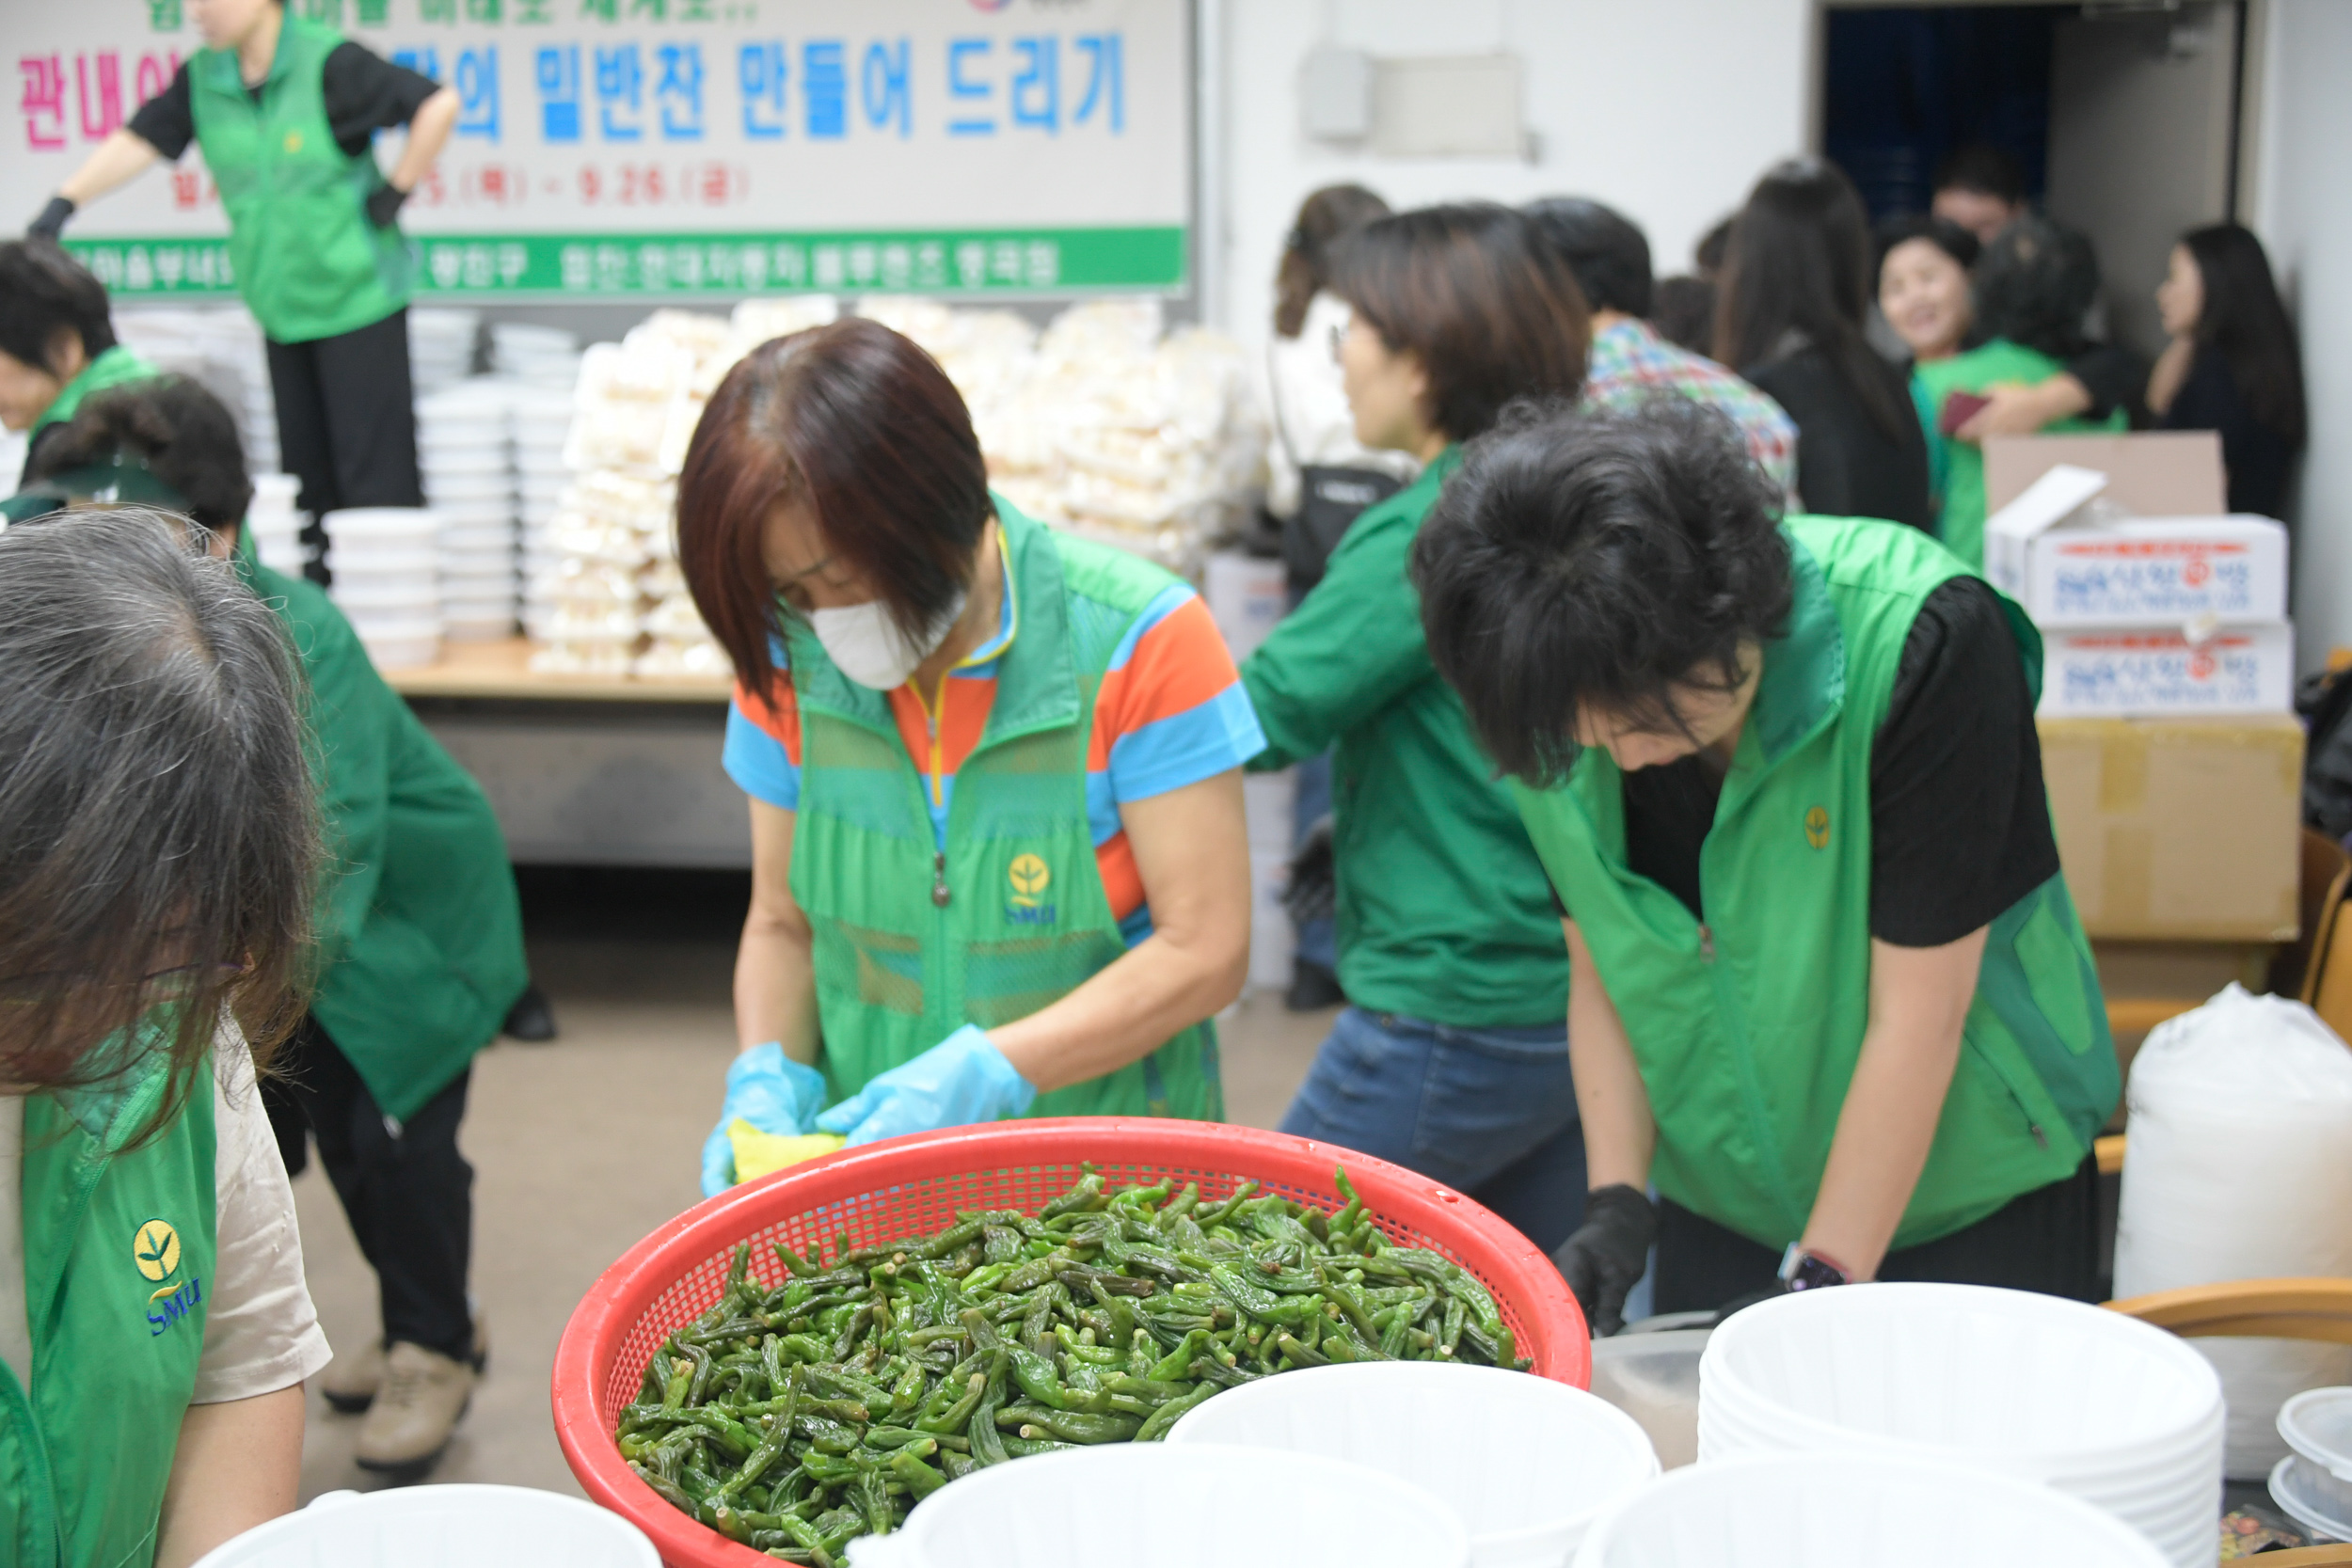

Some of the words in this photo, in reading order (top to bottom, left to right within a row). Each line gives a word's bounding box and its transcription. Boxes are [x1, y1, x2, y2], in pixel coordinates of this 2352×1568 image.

[737, 38, 914, 141] 만들어
[945, 33, 1126, 138] 드리기
[147, 1276, 202, 1338] SMU
